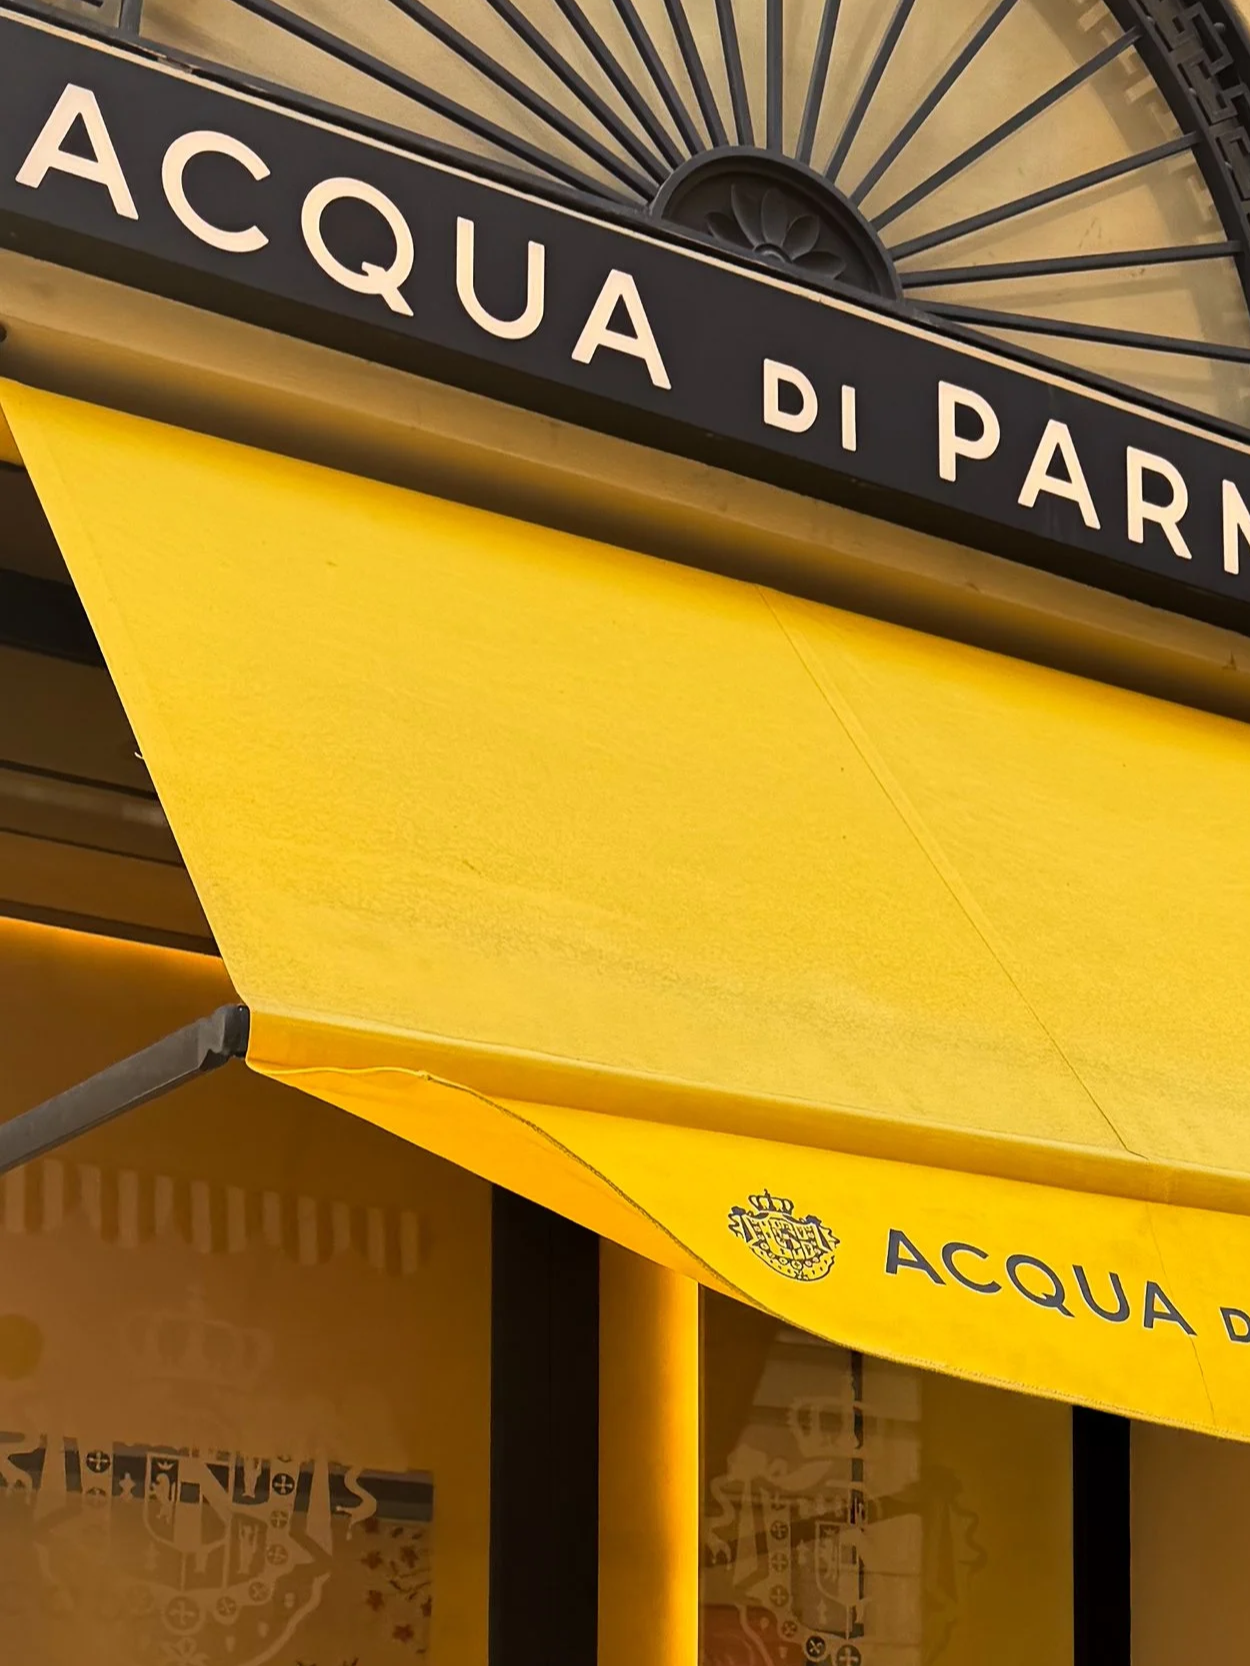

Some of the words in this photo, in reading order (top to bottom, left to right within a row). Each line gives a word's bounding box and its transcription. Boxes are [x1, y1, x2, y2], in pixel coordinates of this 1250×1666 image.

[15, 82, 672, 390] ACQUA
[763, 358, 857, 452] DI
[885, 1228, 1198, 1336] ACQUA
